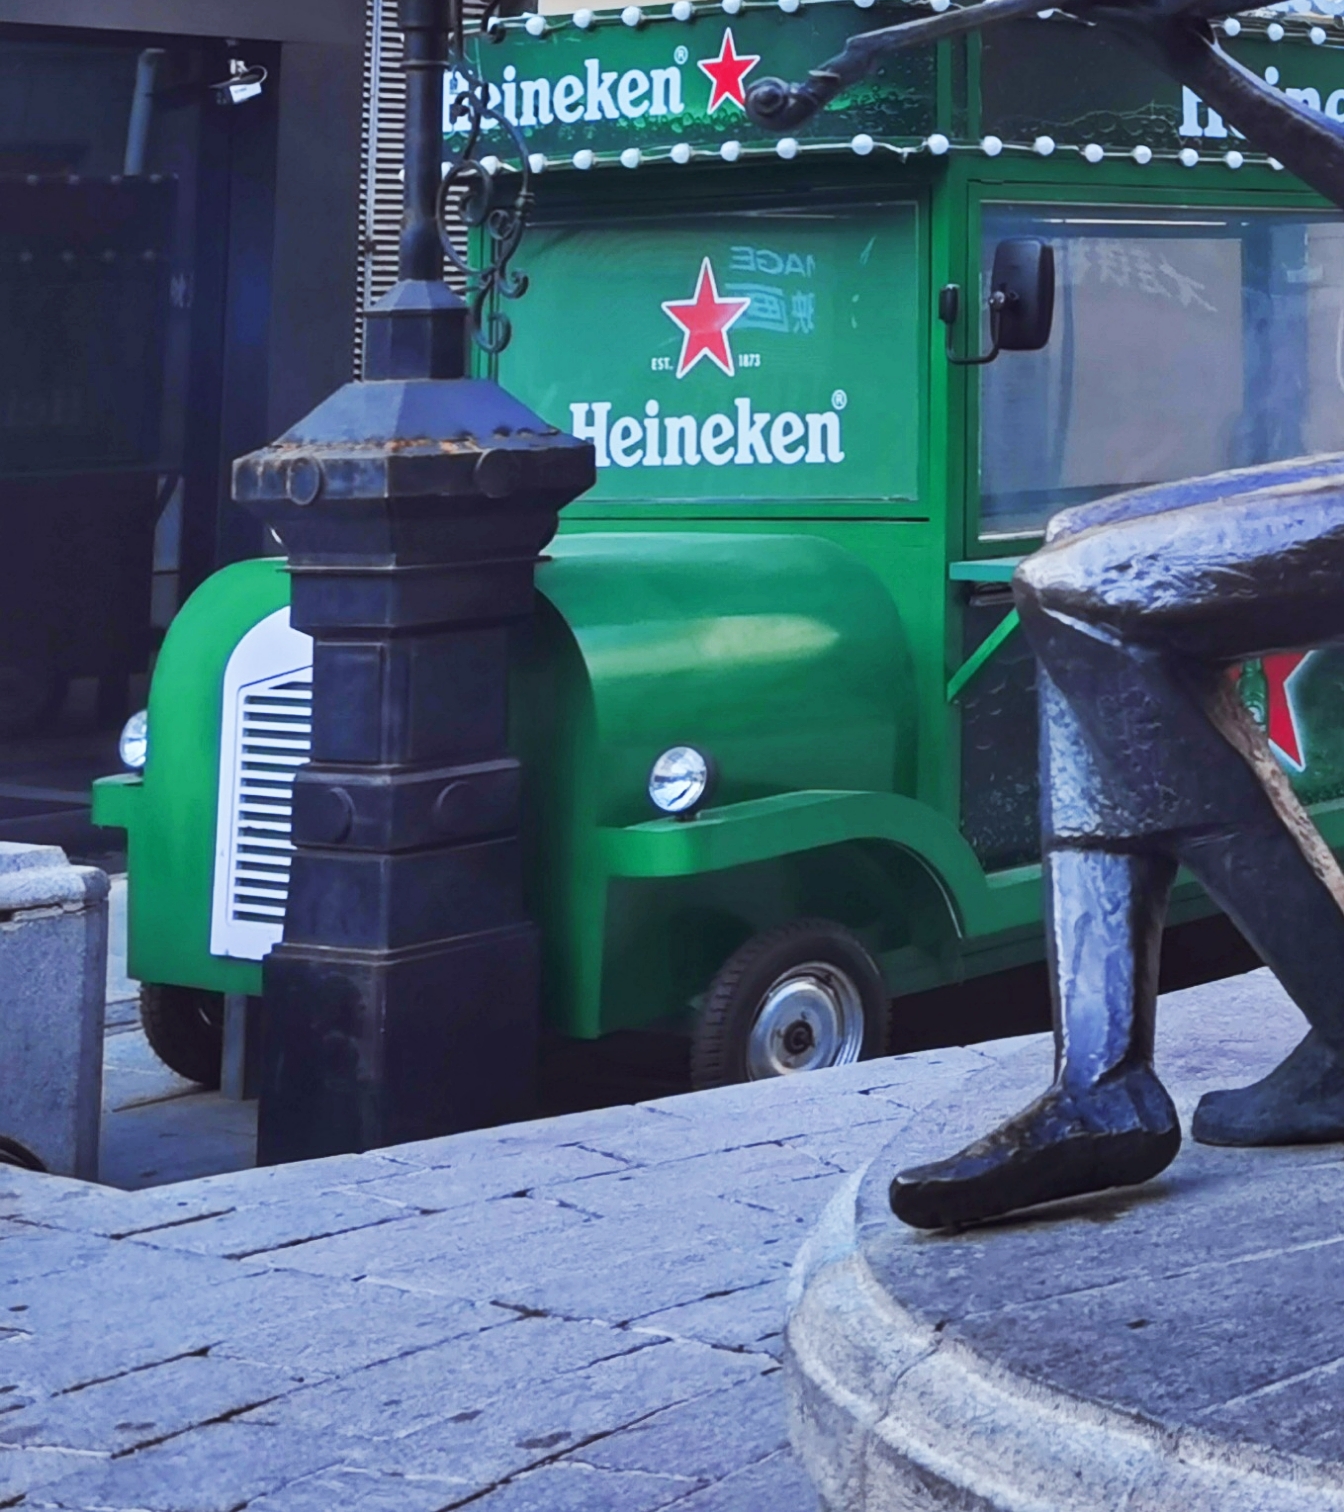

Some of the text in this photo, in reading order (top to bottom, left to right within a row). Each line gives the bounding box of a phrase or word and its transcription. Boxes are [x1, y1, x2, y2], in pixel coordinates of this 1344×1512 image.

[651, 353, 761, 371] EST. 1873
[569, 397, 846, 467] Heineken
